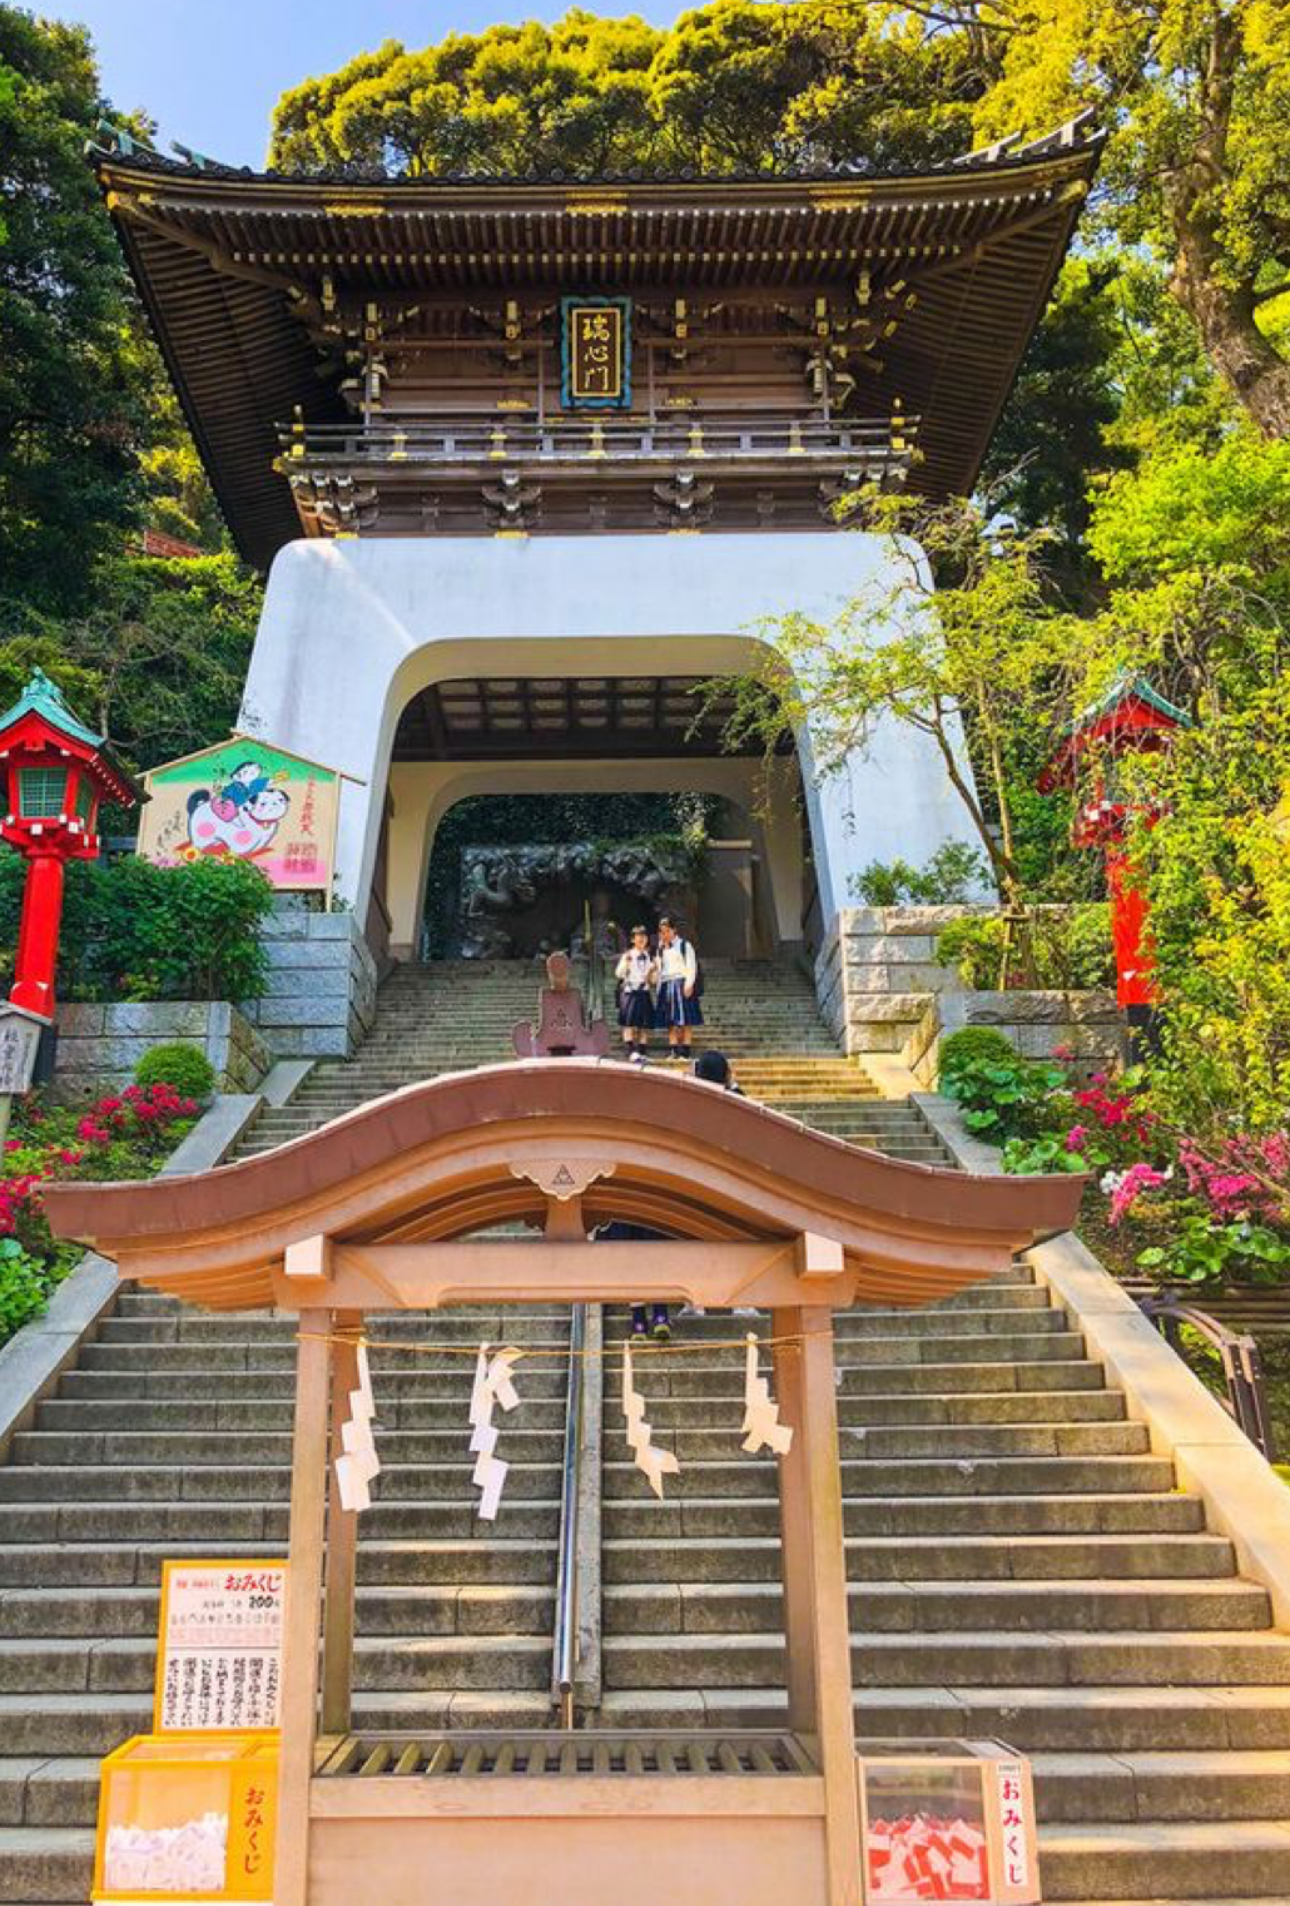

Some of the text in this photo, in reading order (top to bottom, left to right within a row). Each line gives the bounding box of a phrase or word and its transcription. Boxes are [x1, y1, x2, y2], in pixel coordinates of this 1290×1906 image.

[224, 1573, 282, 1593] おみくじ
[244, 1786, 265, 1874] おみくじ
[1002, 1779, 1022, 1884] おみくじ
